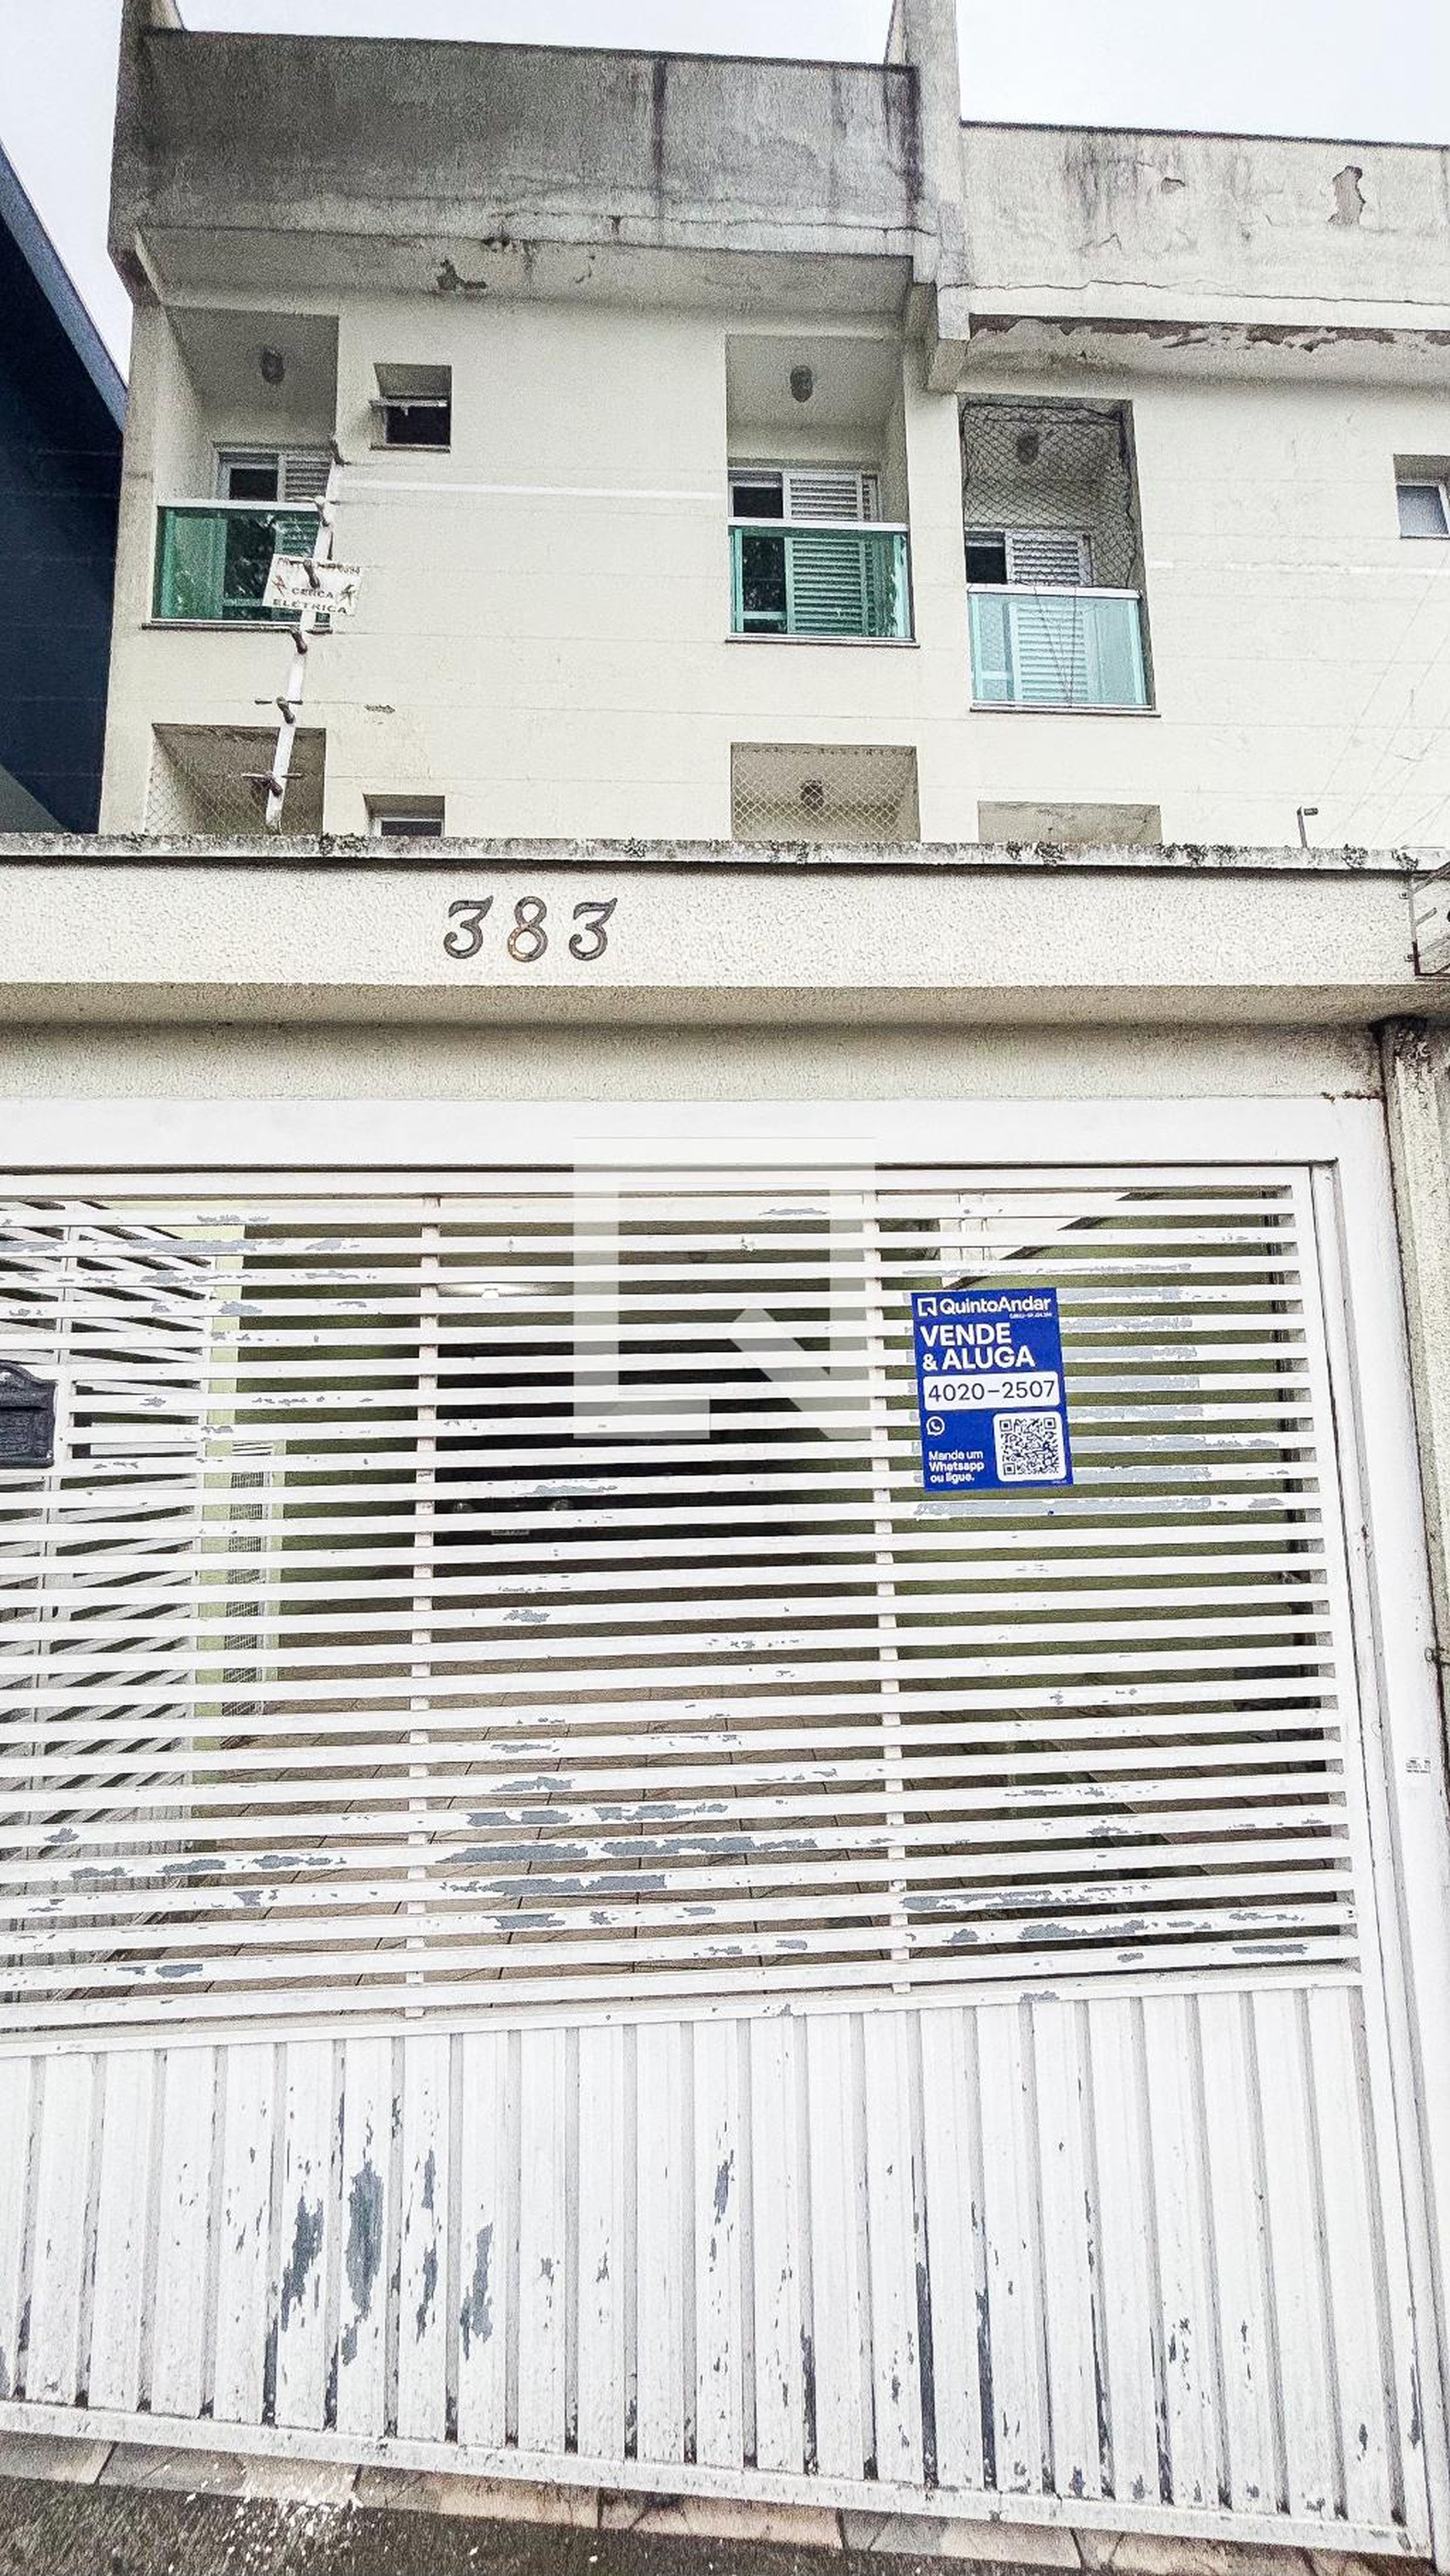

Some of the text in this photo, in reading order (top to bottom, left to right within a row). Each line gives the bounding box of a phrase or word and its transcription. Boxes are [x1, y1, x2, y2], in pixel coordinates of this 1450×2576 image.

[292, 588, 334, 599] CERCA
[443, 895, 618, 962] 383
[940, 1296, 1051, 1315] QuintoAndar
[920, 1322, 1012, 1347] VENDE
[922, 1345, 1036, 1371] & ALUGA
[928, 1380, 1055, 1402] 4020-2507
[928, 1449, 984, 1460] Manda um
[929, 1461, 985, 1472] Whatsapp
[930, 1472, 975, 1485] ou ligue.
